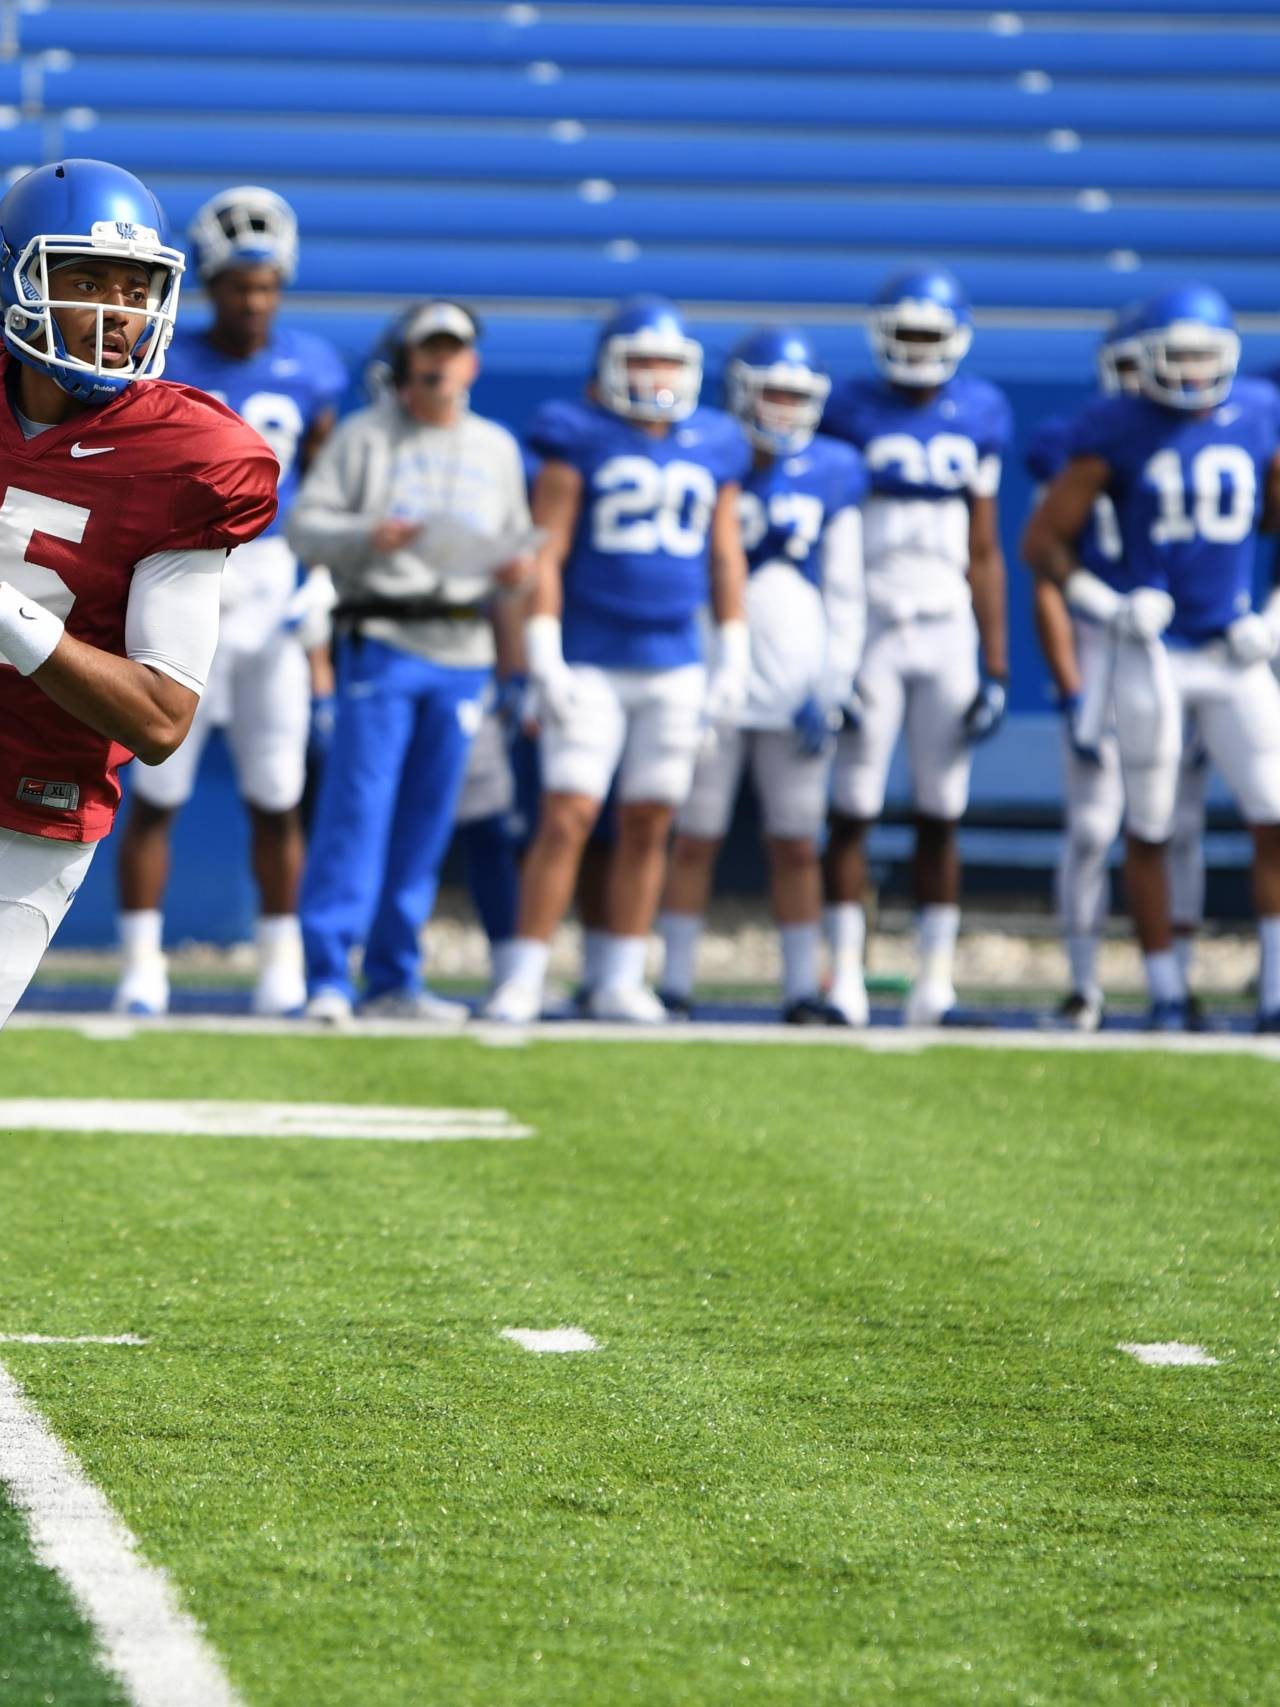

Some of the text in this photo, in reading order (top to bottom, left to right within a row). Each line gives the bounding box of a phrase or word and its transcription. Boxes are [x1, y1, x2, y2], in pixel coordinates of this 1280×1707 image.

[592, 454, 715, 558] 20
[1144, 444, 1256, 544] 10
[51, 786, 65, 797] XL
